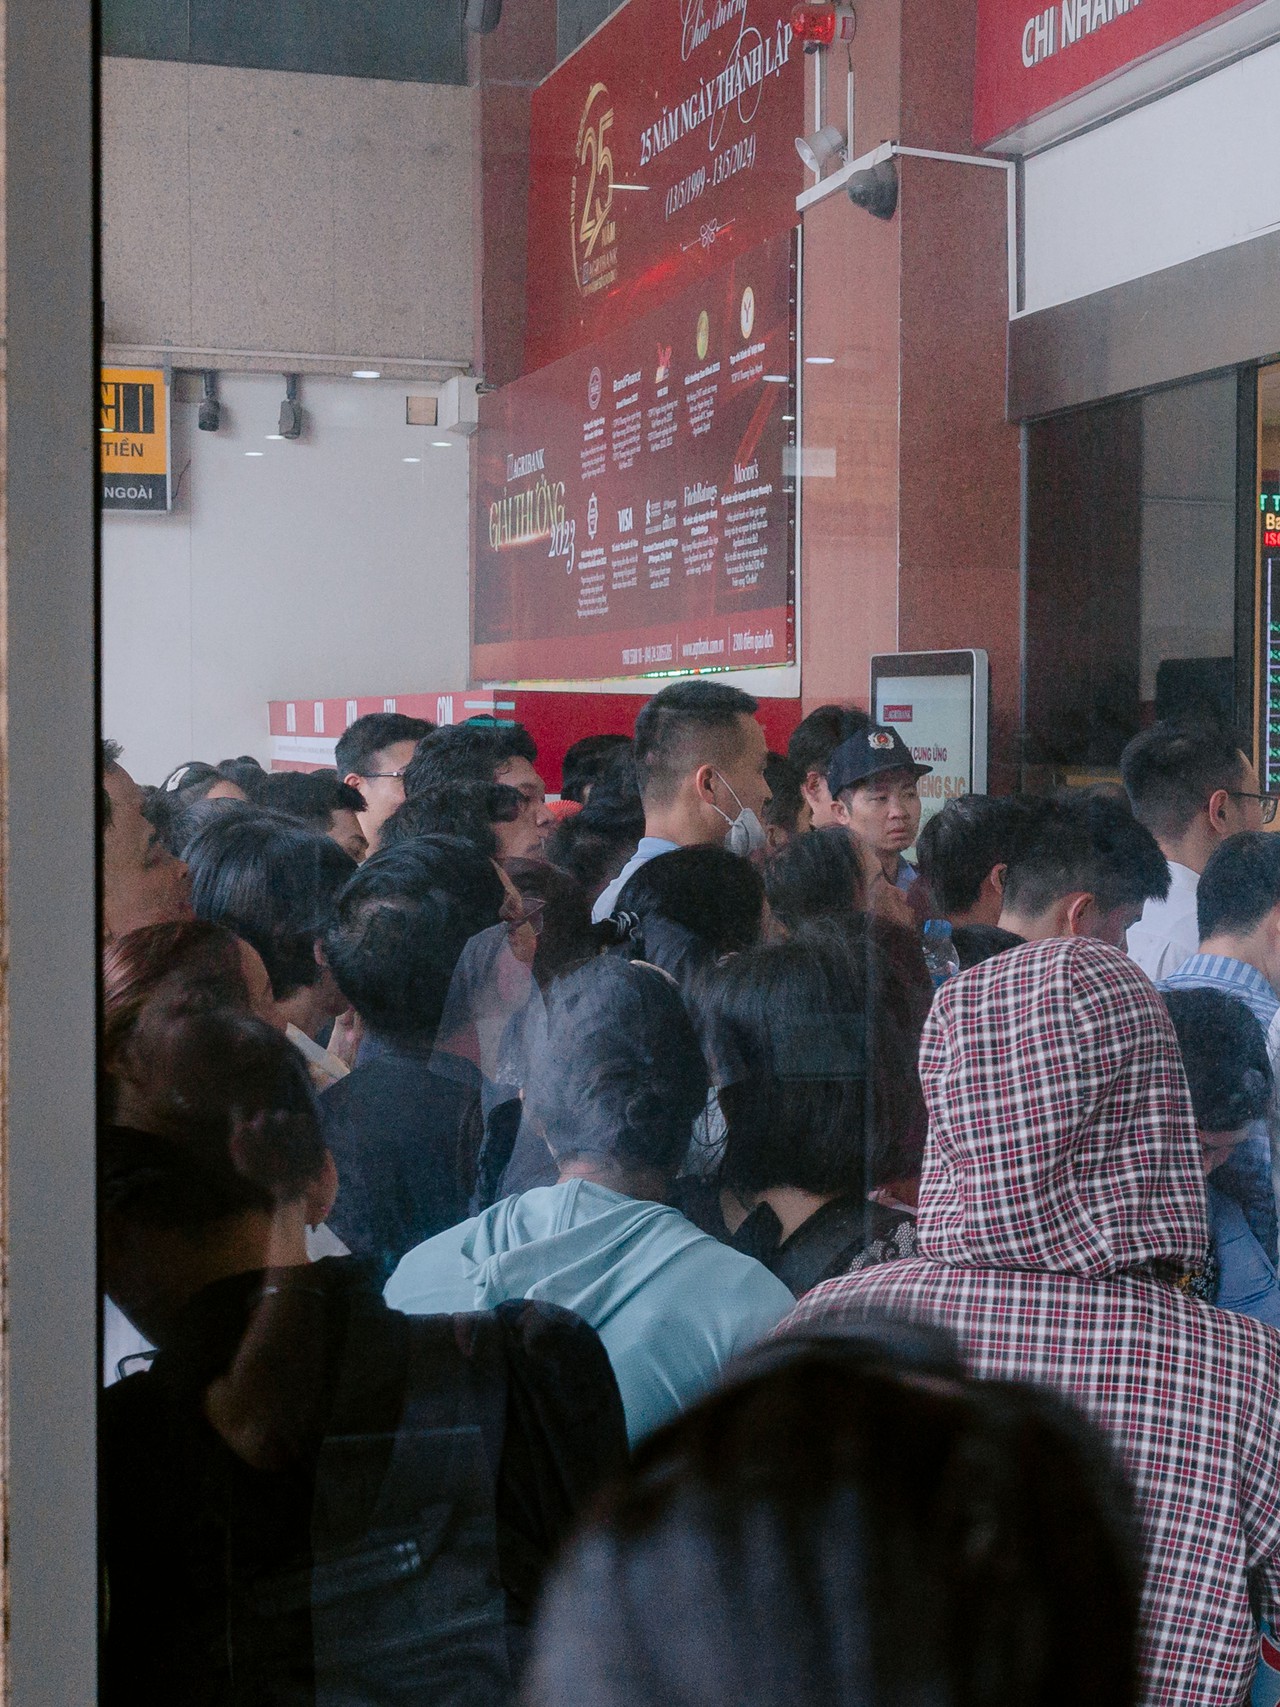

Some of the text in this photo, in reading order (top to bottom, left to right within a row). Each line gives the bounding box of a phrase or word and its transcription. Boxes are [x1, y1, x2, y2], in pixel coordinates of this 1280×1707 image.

[1022, 6, 1056, 68] CHI
[640, 19, 793, 166] 25 NĂM NGÀY THÀNH LẬP
[102, 437, 144, 457] TIỀN
[104, 485, 153, 499] NGOÀI
[618, 507, 633, 532] VISA
[548, 519, 576, 574] 2023
[913, 747, 932, 761] CUNG
[944, 775, 966, 799] SJC
